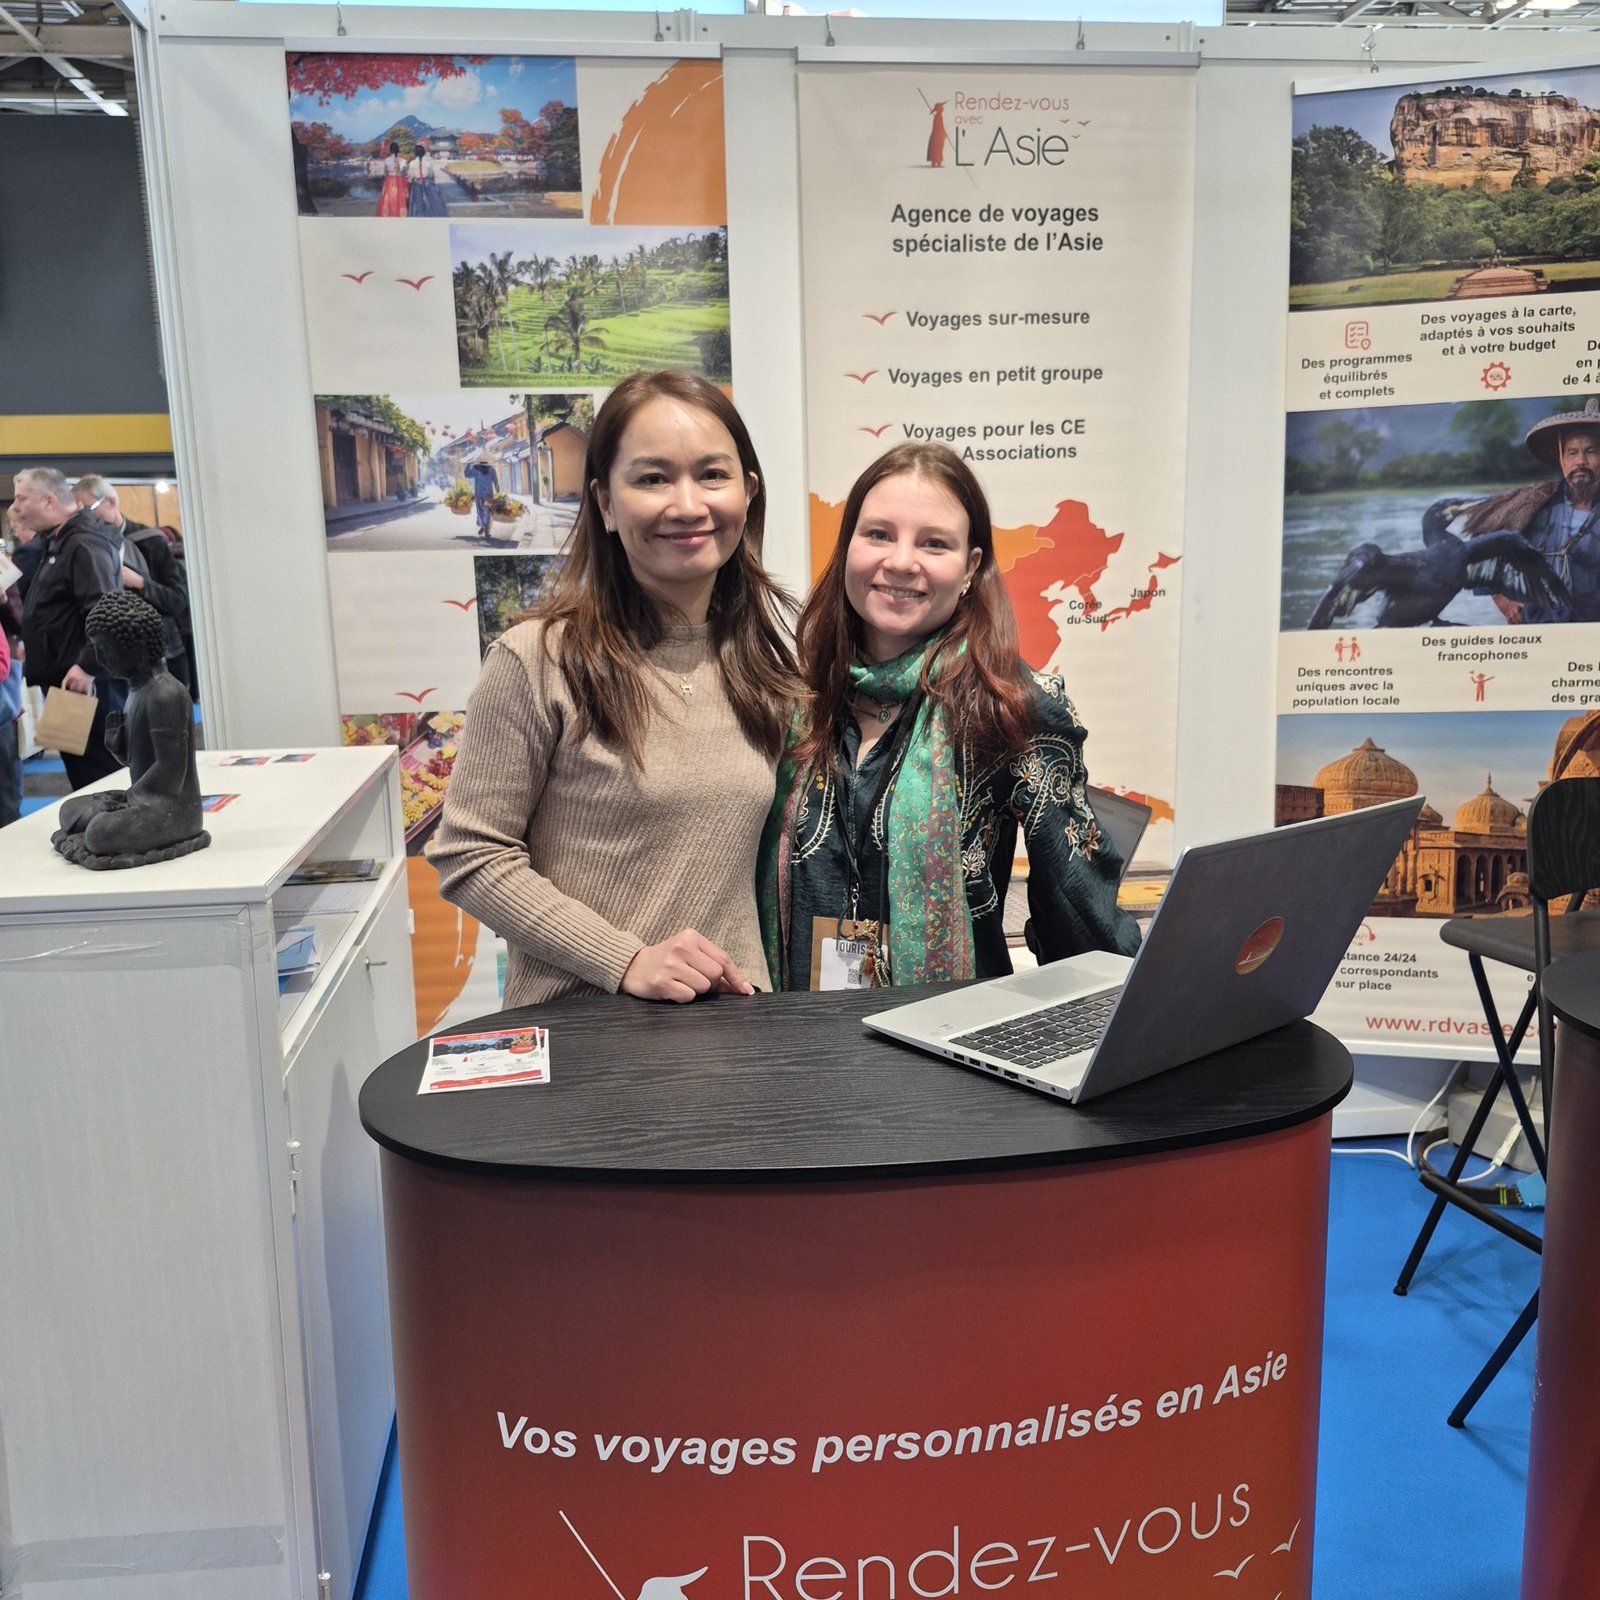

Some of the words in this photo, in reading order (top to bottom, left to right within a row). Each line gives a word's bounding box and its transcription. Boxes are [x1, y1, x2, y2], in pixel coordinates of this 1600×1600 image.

[954, 91, 1070, 111] Rendez-vous
[954, 115, 983, 125] avec
[891, 204, 971, 227] Agence
[978, 204, 1005, 223] de
[1011, 206, 1099, 227] voyages
[892, 234, 1007, 256] spécialiste
[1013, 234, 1039, 252] de
[906, 312, 982, 330] Voyages
[988, 310, 1090, 326] sur-mesure
[1420, 313, 1446, 326] Des
[1450, 311, 1507, 324] voyages
[1511, 307, 1519, 319] à
[1523, 306, 1535, 318] la
[1539, 305, 1577, 317] carte,
[1420, 327, 1473, 342] adaptés
[1478, 326, 1485, 337] à
[1490, 327, 1514, 336] vos
[1517, 320, 1576, 334] souhaits
[1442, 345, 1454, 357] et
[1458, 342, 1466, 355] à
[1471, 342, 1505, 354] votre
[1509, 338, 1557, 353] budget
[1587, 340, 1600, 351] D
[1301, 358, 1325, 369] Des
[1329, 353, 1412, 369] programmes
[1576, 359, 1592, 368] en
[888, 369, 963, 387] Voyages
[969, 371, 990, 383] en
[996, 366, 1036, 386] petit
[1041, 367, 1104, 385] groupe
[1323, 370, 1388, 385] équilibrés
[1562, 374, 1579, 385] de
[1583, 373, 1591, 383] 4
[1319, 389, 1331, 400] et
[1335, 386, 1395, 400] complets
[903, 423, 977, 442] Voyages
[983, 424, 1024, 440] pour
[1030, 420, 1055, 436] les
[1061, 419, 1086, 435] CE
[962, 444, 1078, 461] Associations
[1130, 588, 1166, 599] Japon
[1068, 599, 1102, 611] Corée
[1066, 615, 1081, 625] du
[1084, 613, 1107, 624] Sud
[1421, 637, 1447, 647] Des
[1450, 635, 1495, 649] guides
[1499, 634, 1542, 645] locaux
[1437, 649, 1528, 662] francophones
[1298, 667, 1321, 678] Des
[1325, 665, 1393, 677] rencontres
[1567, 661, 1593, 672] Des
[1296, 682, 1346, 694] uniques
[1349, 681, 1379, 691] avec
[1383, 680, 1394, 691] la
[1551, 677, 1600, 688] charme
[1293, 696, 1359, 708] population
[1362, 694, 1400, 706] locale
[1551, 693, 1575, 703] des
[1580, 694, 1600, 705] gra
[1343, 952, 1380, 962] tance
[1383, 952, 1417, 963] 24/24
[1340, 967, 1438, 979] correspondants
[1335, 981, 1355, 989] sur
[1359, 980, 1392, 991] place
[496, 1411, 577, 1458] Vos
[594, 1433, 797, 1474] voyages
[810, 1393, 1142, 1475] personnalisés
[1155, 1382, 1203, 1419] en
[1213, 1349, 1288, 1404] Asie
[743, 1483, 1251, 1600] Rendez-vous
